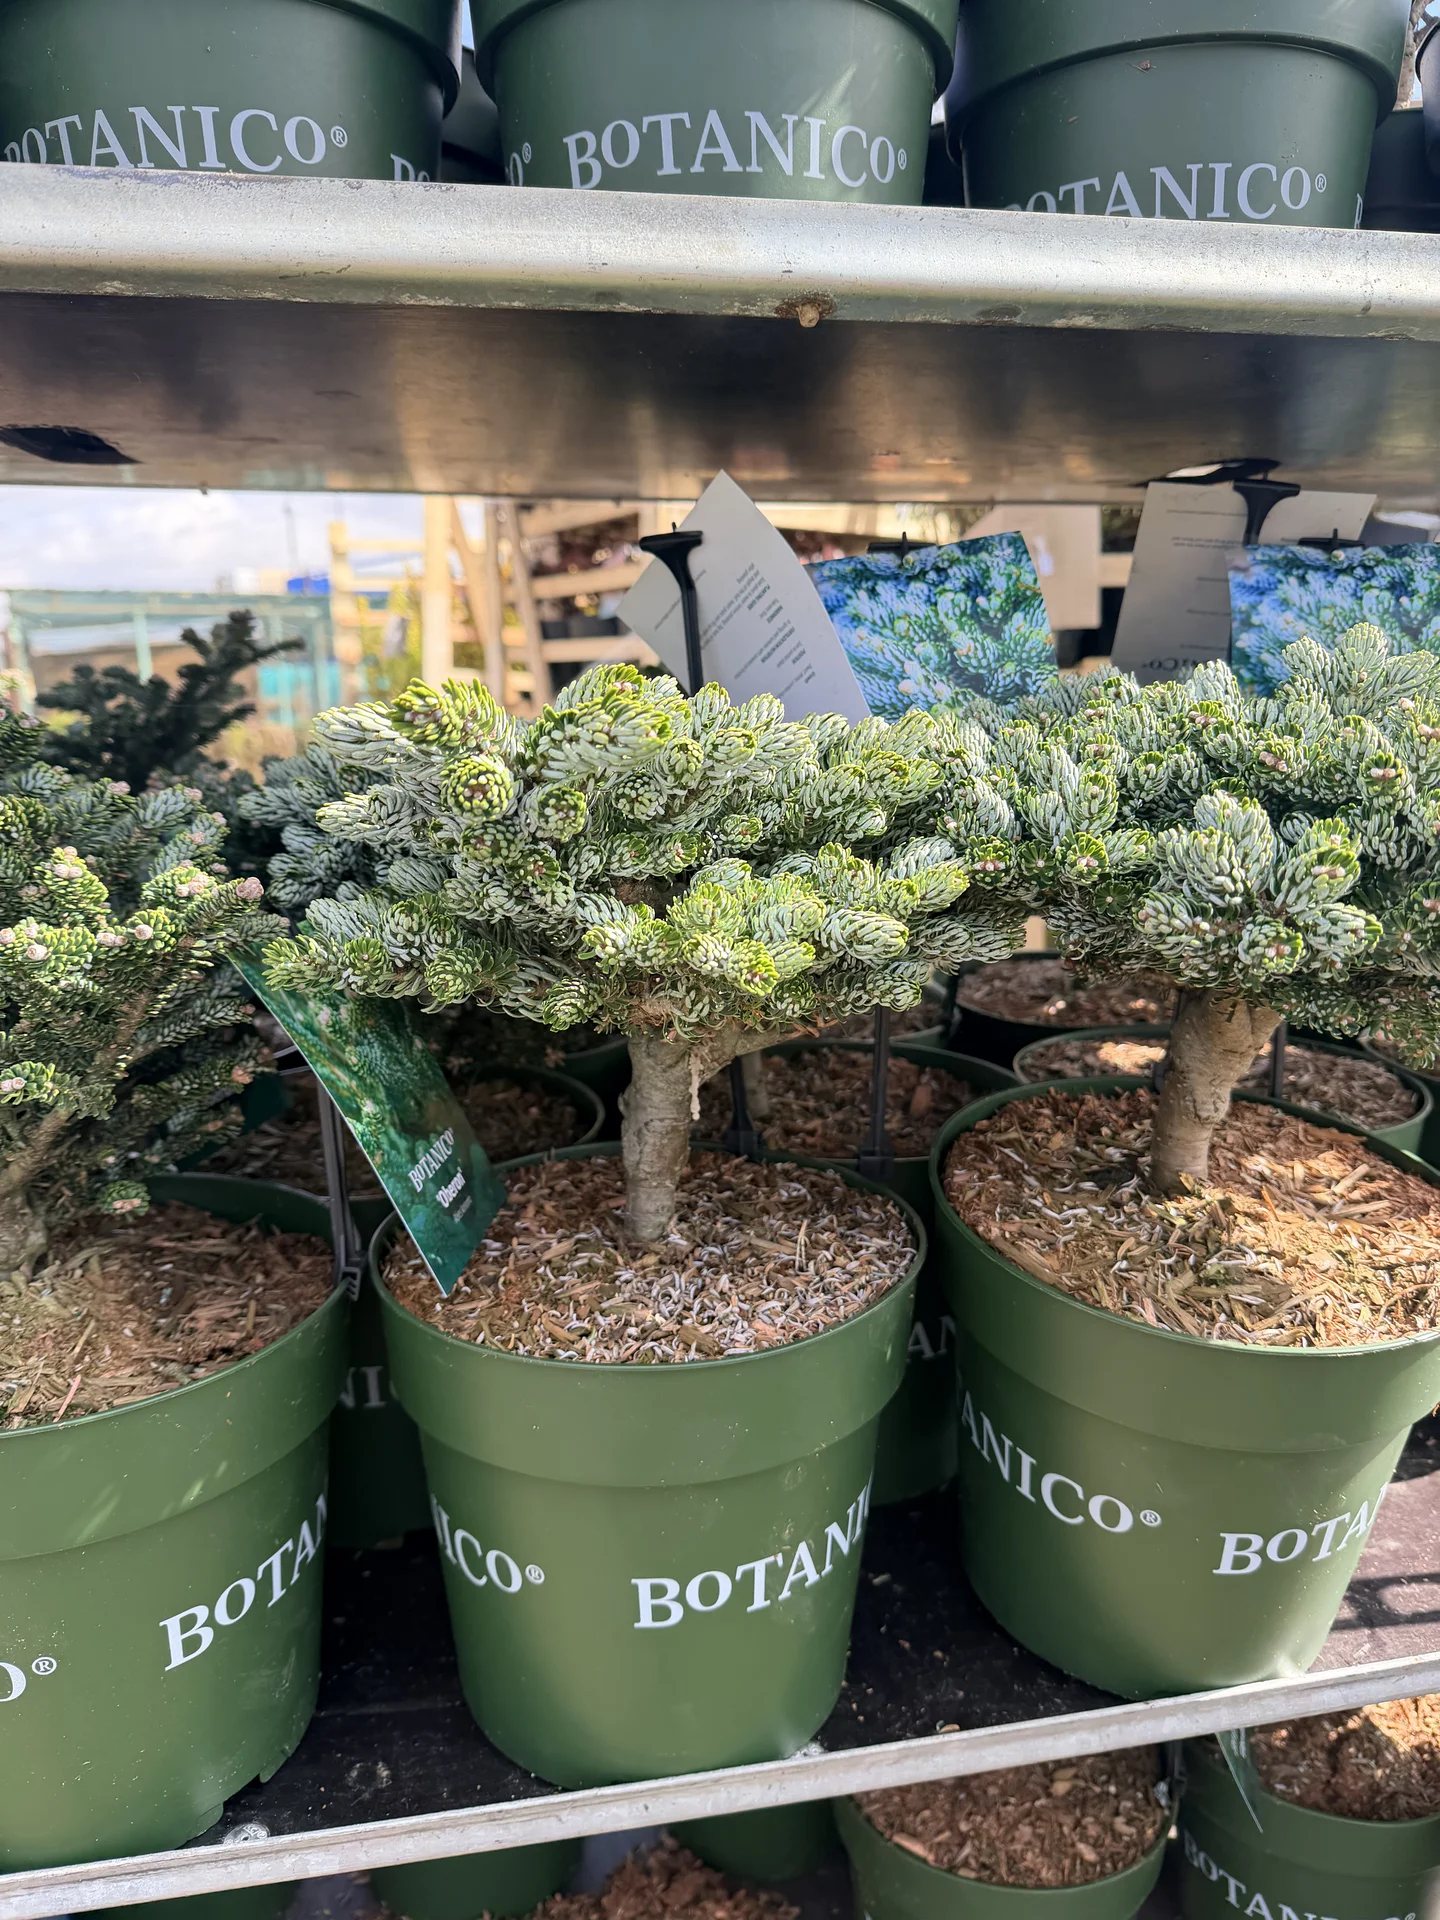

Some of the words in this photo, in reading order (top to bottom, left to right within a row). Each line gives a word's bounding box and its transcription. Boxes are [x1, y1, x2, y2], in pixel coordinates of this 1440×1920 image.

[1003, 162, 1327, 220] TANICO®
[431, 1494, 545, 1594] ICO®
[631, 1470, 873, 1629] BOTANI
